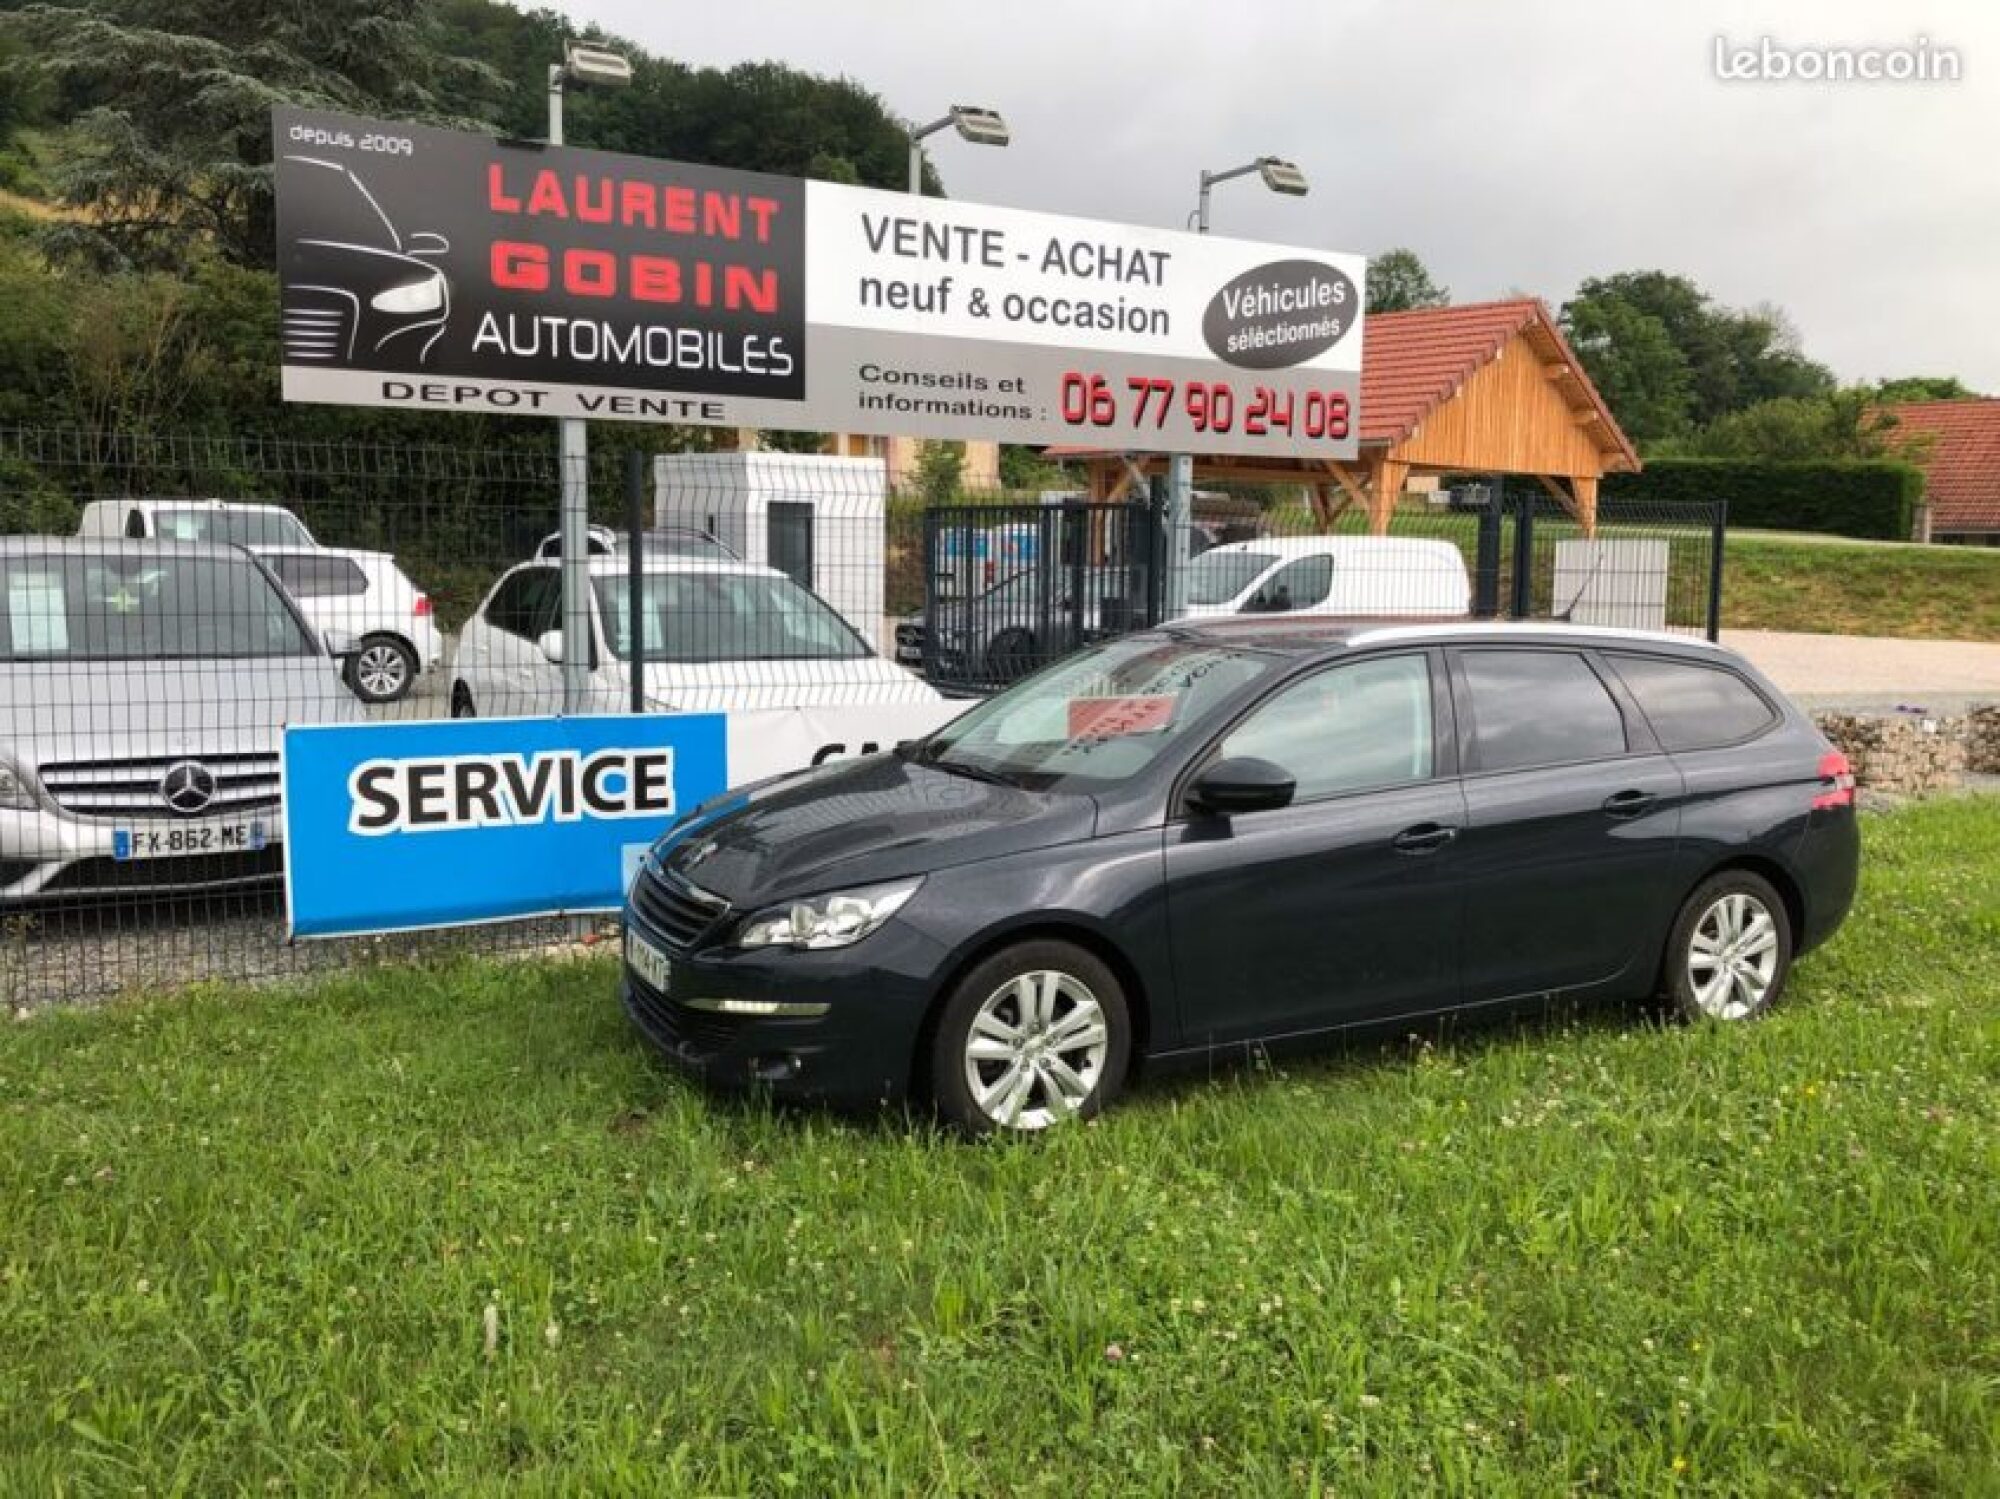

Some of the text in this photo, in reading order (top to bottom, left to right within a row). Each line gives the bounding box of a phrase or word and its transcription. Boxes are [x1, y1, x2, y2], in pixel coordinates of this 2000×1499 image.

[289, 124, 414, 157] depuis 2009
[487, 162, 781, 244] LAURENT
[490, 239, 779, 314] GOBIN
[861, 212, 1006, 268] VENTE
[1040, 237, 1172, 287] ACHAT
[860, 276, 1170, 336] neuf & occasion
[1222, 276, 1346, 320] Véhicules
[471, 311, 793, 377] AUTOMOBILES
[382, 380, 727, 420] DEPOT VENTE
[858, 363, 1027, 395] Conseils et
[858, 391, 1033, 422] informations
[1061, 371, 1351, 440] 06 77 90 24 08
[351, 750, 673, 831] SERVICE
